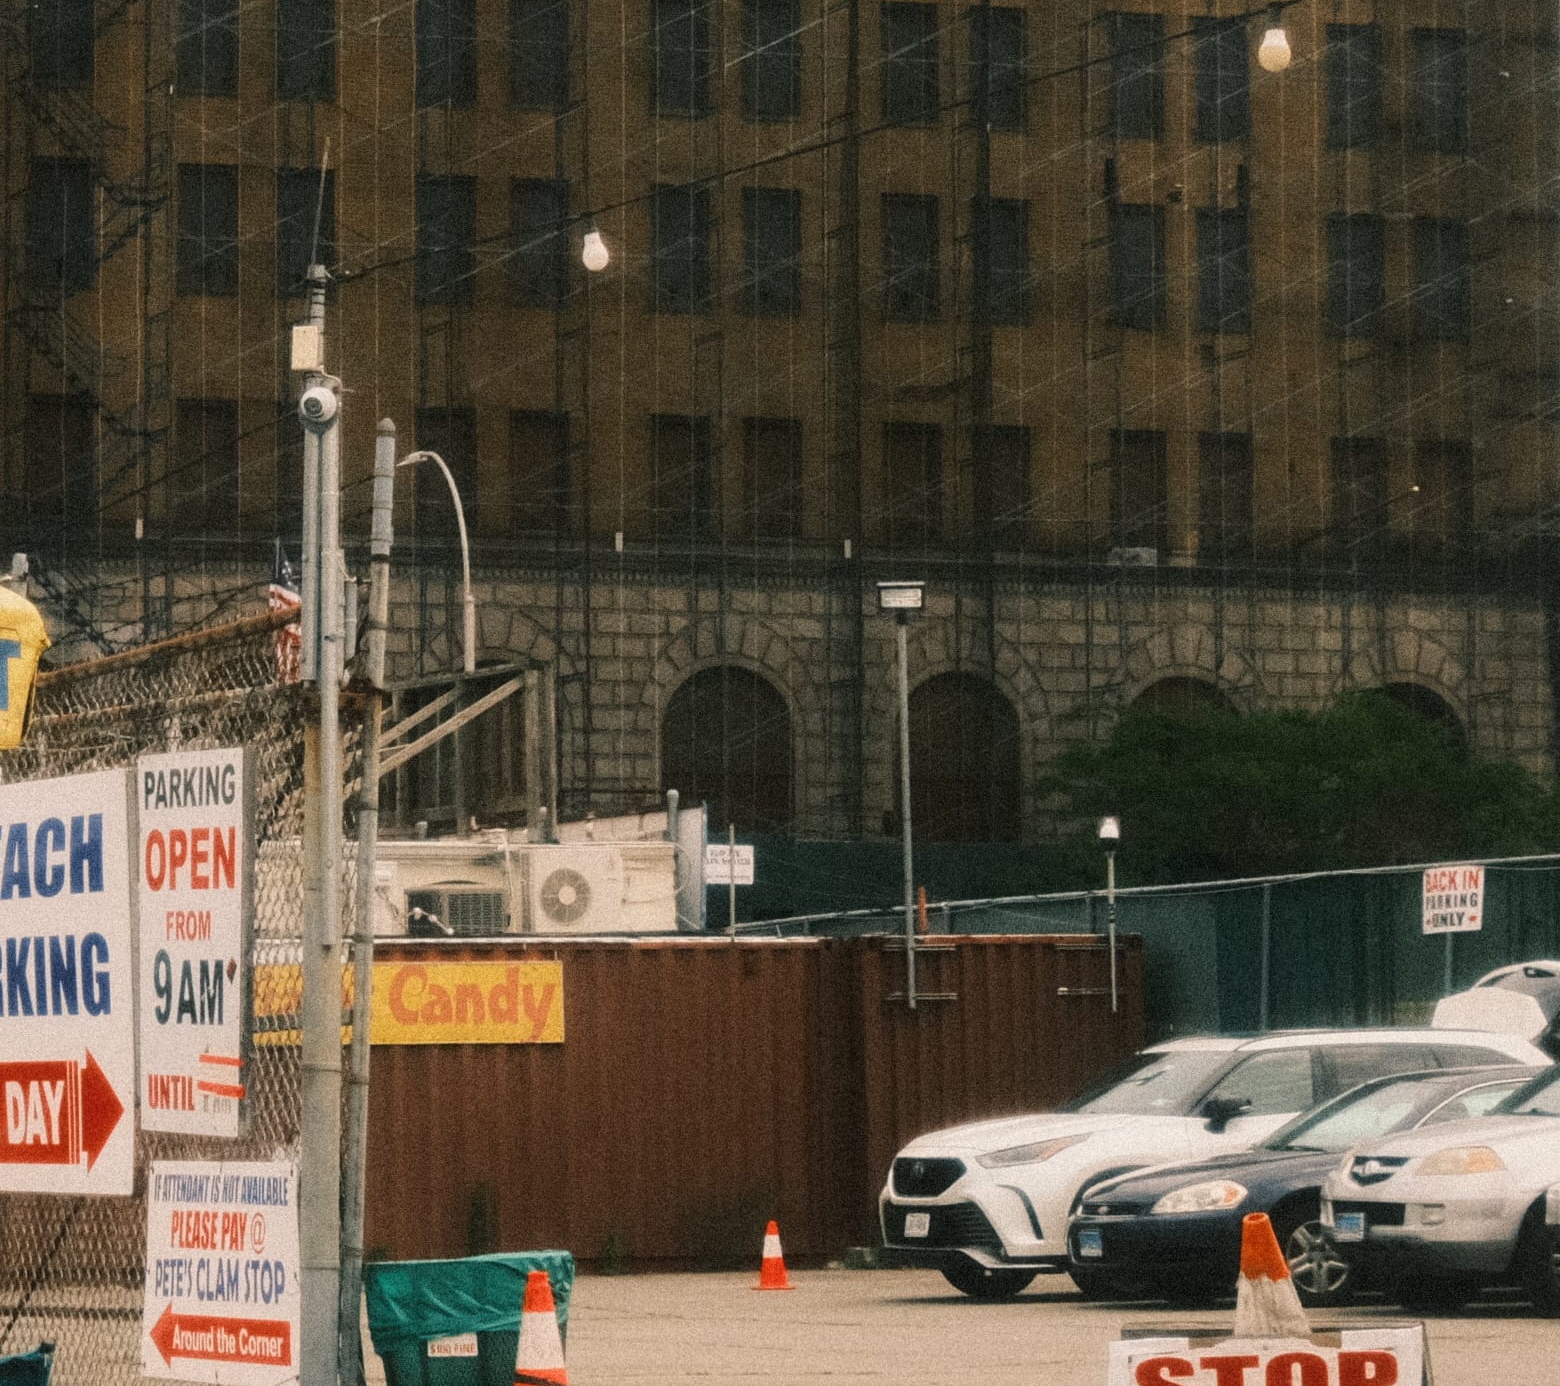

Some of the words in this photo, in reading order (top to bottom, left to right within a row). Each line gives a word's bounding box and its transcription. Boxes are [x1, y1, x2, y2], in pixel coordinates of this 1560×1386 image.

[144, 765, 237, 810] PARKING
[145, 826, 238, 892] OPEN
[165, 911, 212, 942] FROM
[1432, 912, 1465, 928] ONLY
[388, 963, 556, 1043] Candy
[5, 1079, 65, 1146] DAY
[147, 1074, 195, 1111] UNTIL
[153, 1174, 161, 1202] IF
[162, 1173, 209, 1204] ATTENDANT
[210, 1175, 220, 1204] IS
[223, 1175, 240, 1204] NOT
[241, 1176, 289, 1207] AVAILABLE
[171, 1209, 218, 1250] PLEASE
[221, 1211, 248, 1252] PAY
[251, 1212, 266, 1254] @
[154, 1258, 193, 1298] PETE'S
[196, 1257, 239, 1303] CLAM
[245, 1258, 286, 1305] STOP
[172, 1324, 214, 1353] Around
[217, 1326, 236, 1354] the
[239, 1327, 284, 1358] Corner
